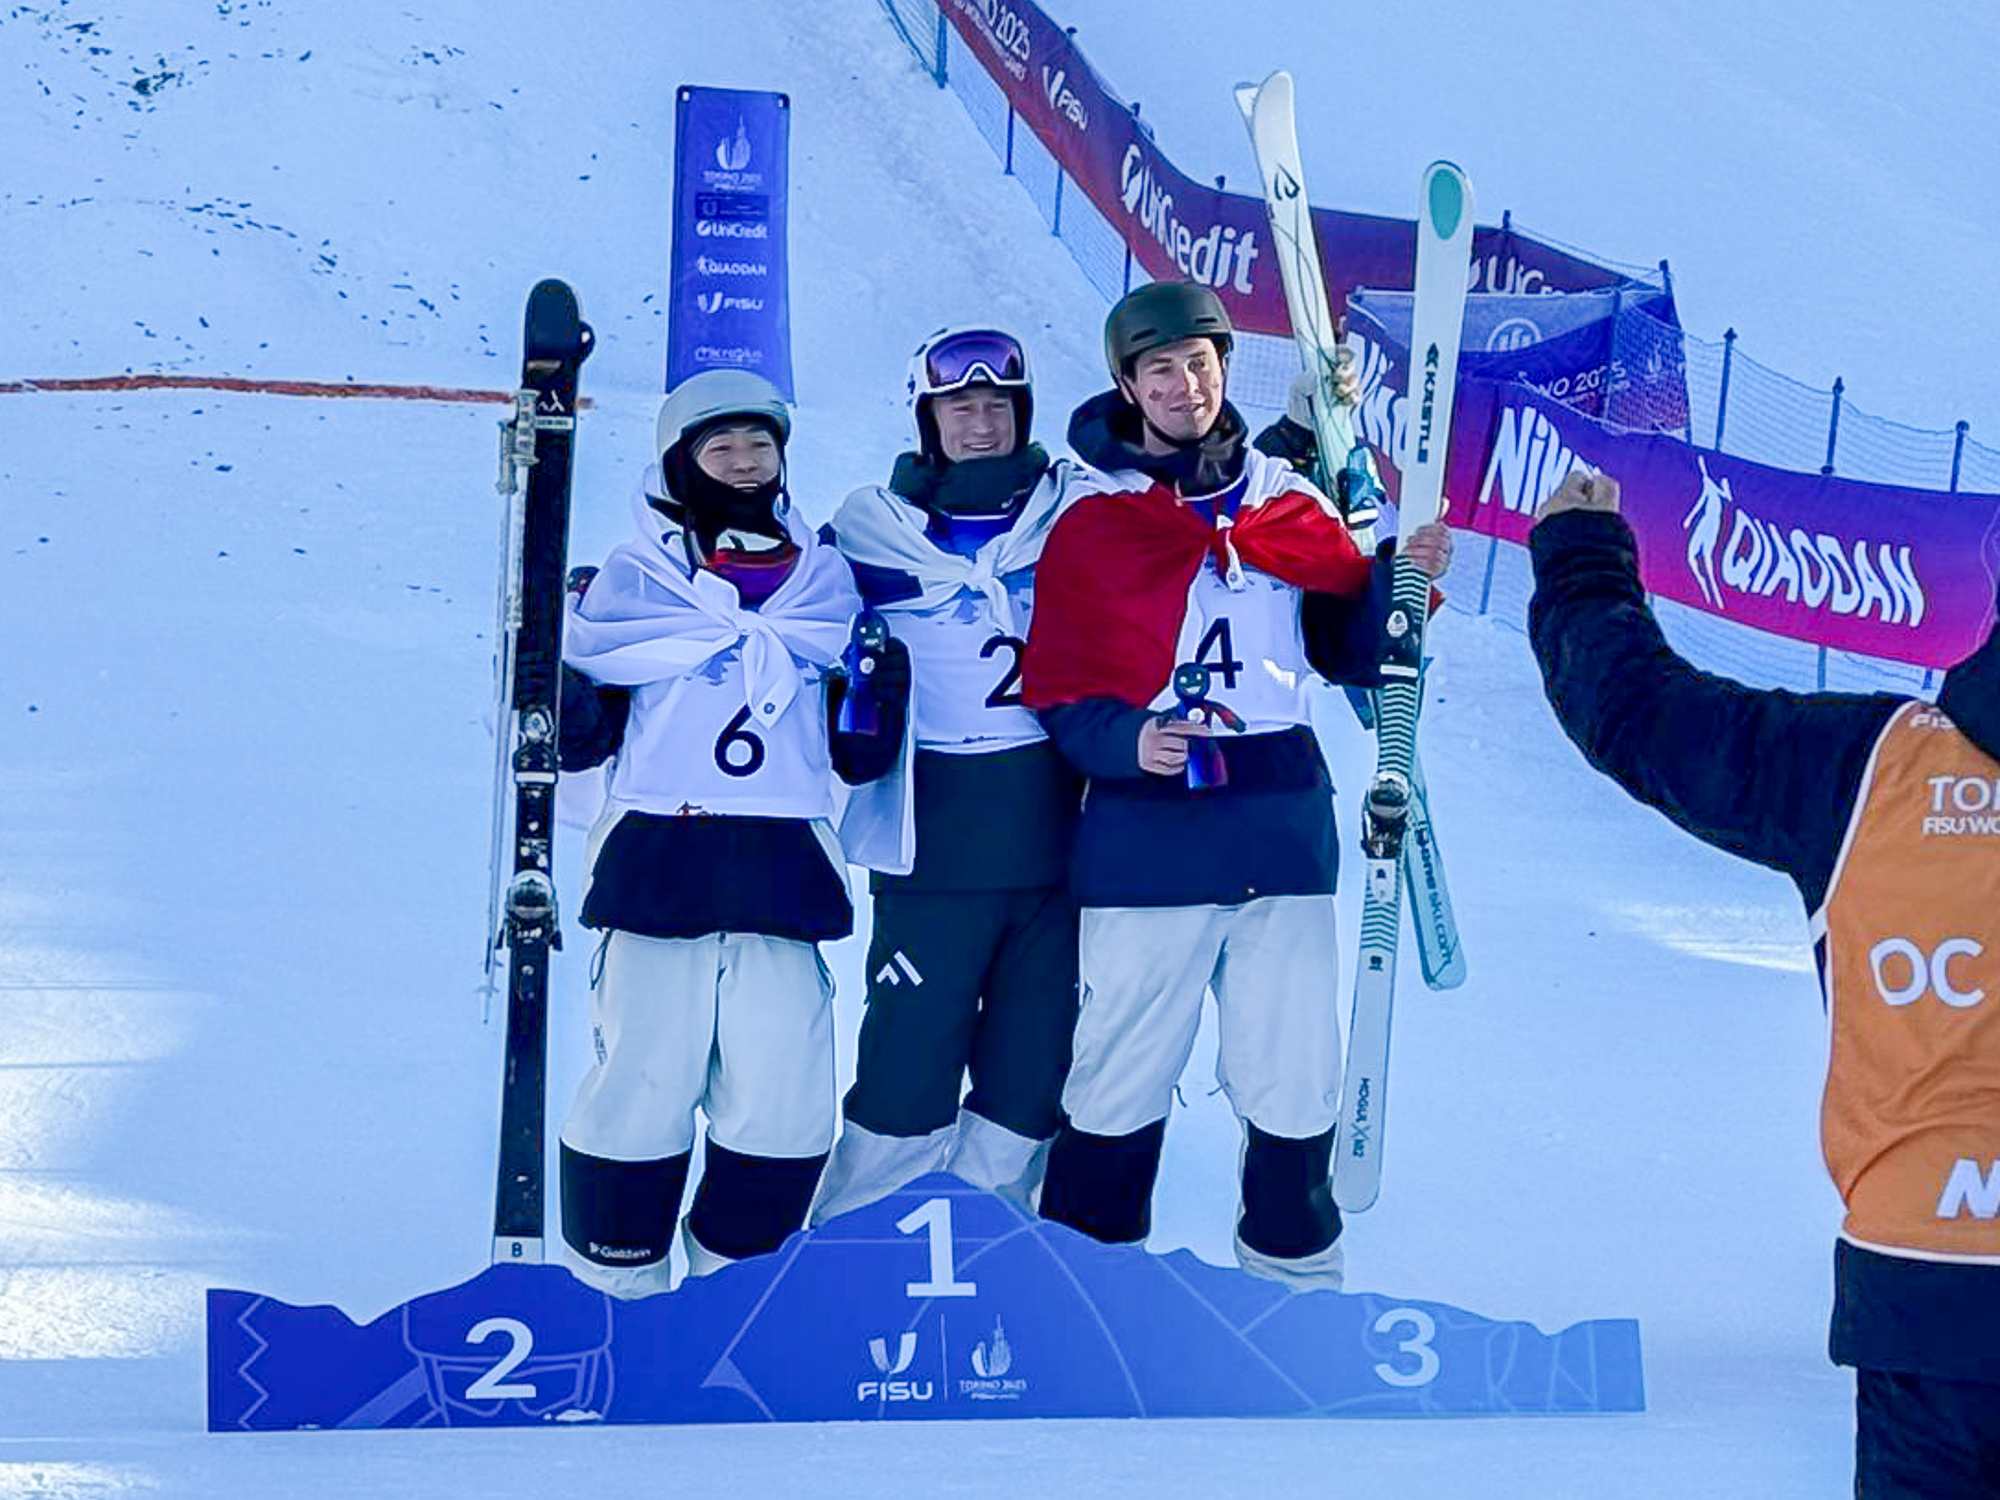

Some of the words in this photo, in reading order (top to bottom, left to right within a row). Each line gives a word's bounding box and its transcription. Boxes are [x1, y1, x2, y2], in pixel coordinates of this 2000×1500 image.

[1141, 164, 1259, 295] UniCredit
[1721, 508, 1925, 627] QIAODAN
[979, 634, 1028, 708] 2
[1196, 617, 1243, 689] 4
[714, 703, 765, 778] 6
[1870, 938, 1985, 1007] OC
[896, 1198, 977, 1297] 1
[465, 1317, 537, 1400] 2
[1375, 1308, 1440, 1387] 3
[858, 1381, 933, 1401] FISU
